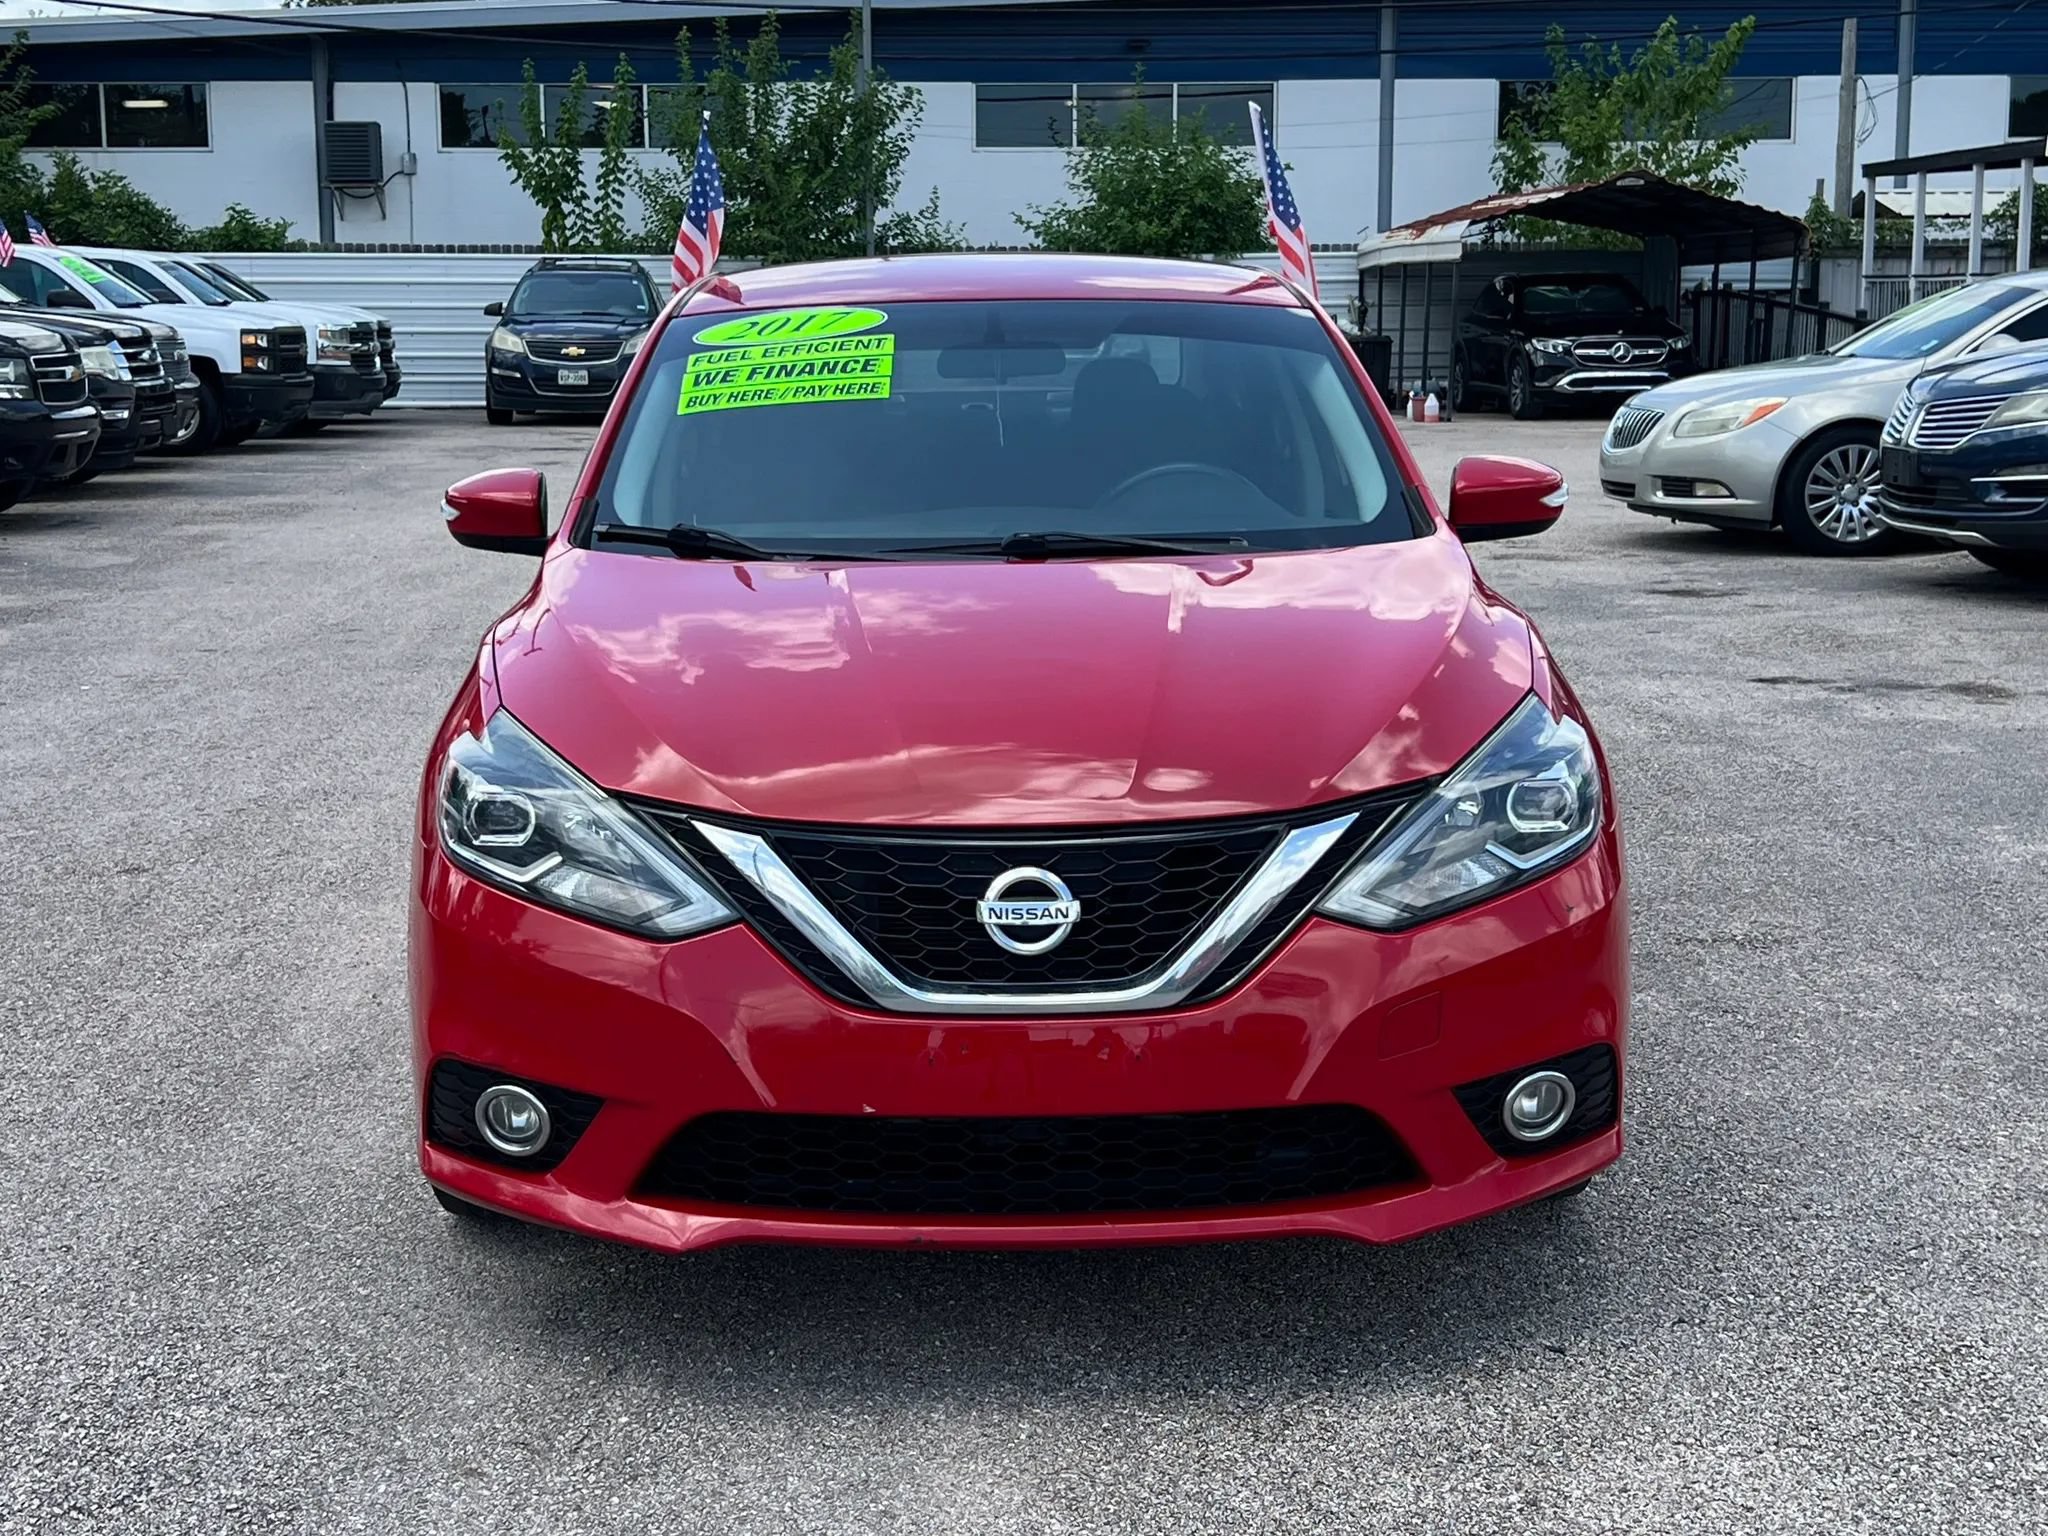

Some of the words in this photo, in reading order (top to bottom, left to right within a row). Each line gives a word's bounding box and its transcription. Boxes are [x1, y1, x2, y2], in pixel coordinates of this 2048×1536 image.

[722, 311, 854, 341] 2017
[692, 350, 752, 368] FUEL
[761, 337, 888, 359] EFFICIENT
[692, 369, 739, 388] WE
[746, 358, 881, 381] FINANCE
[685, 393, 724, 409] BUY
[726, 388, 777, 403] HERE
[792, 384, 829, 398] PAY
[832, 382, 883, 396] HERE
[988, 907, 1069, 920] NISSAN
